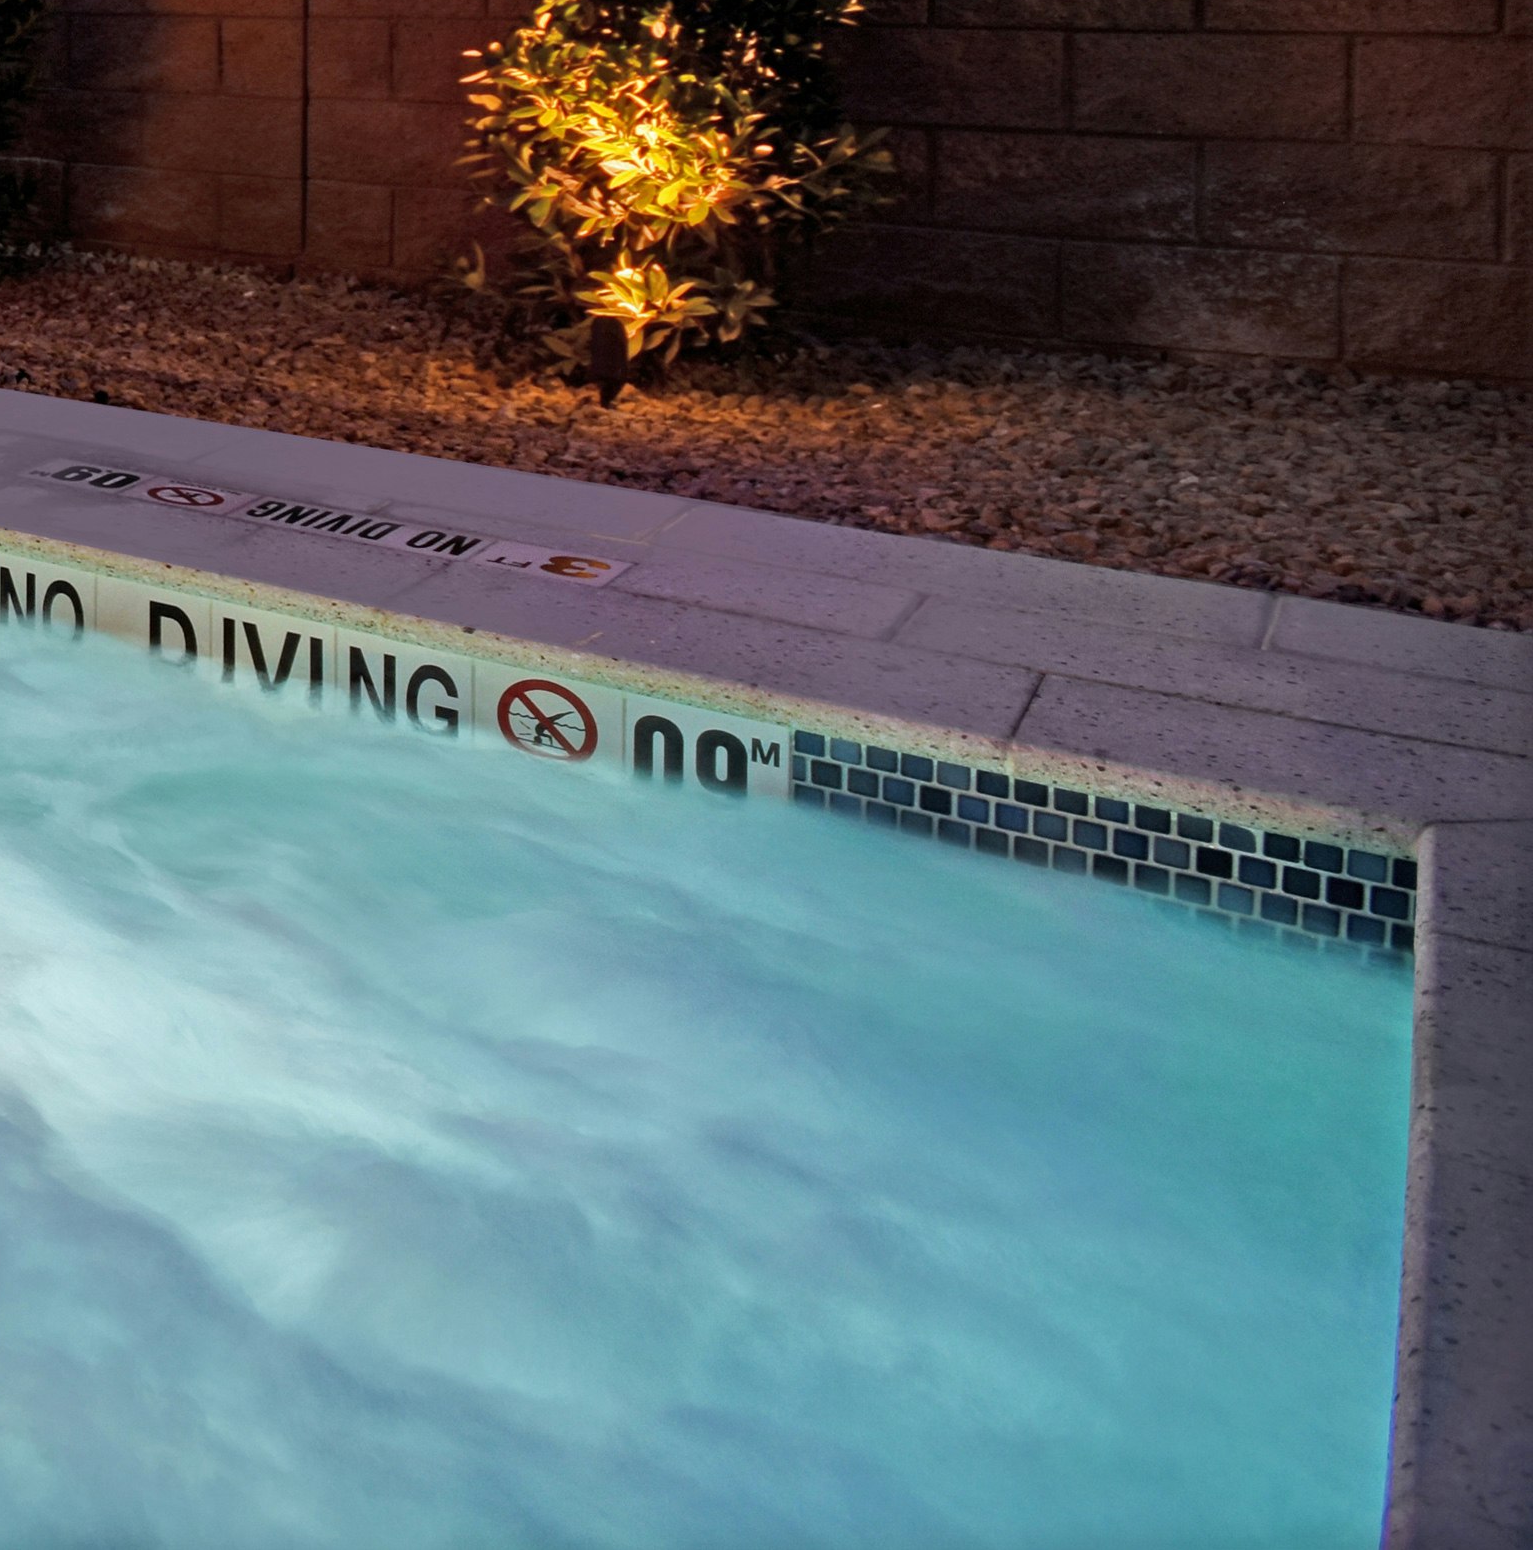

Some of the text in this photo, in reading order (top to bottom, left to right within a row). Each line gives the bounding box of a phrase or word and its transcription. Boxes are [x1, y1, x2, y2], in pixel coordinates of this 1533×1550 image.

[246, 500, 405, 541] DIVING
[406, 530, 484, 557] NO
[0, 565, 85, 642] NO
[148, 599, 459, 739] DIVING
